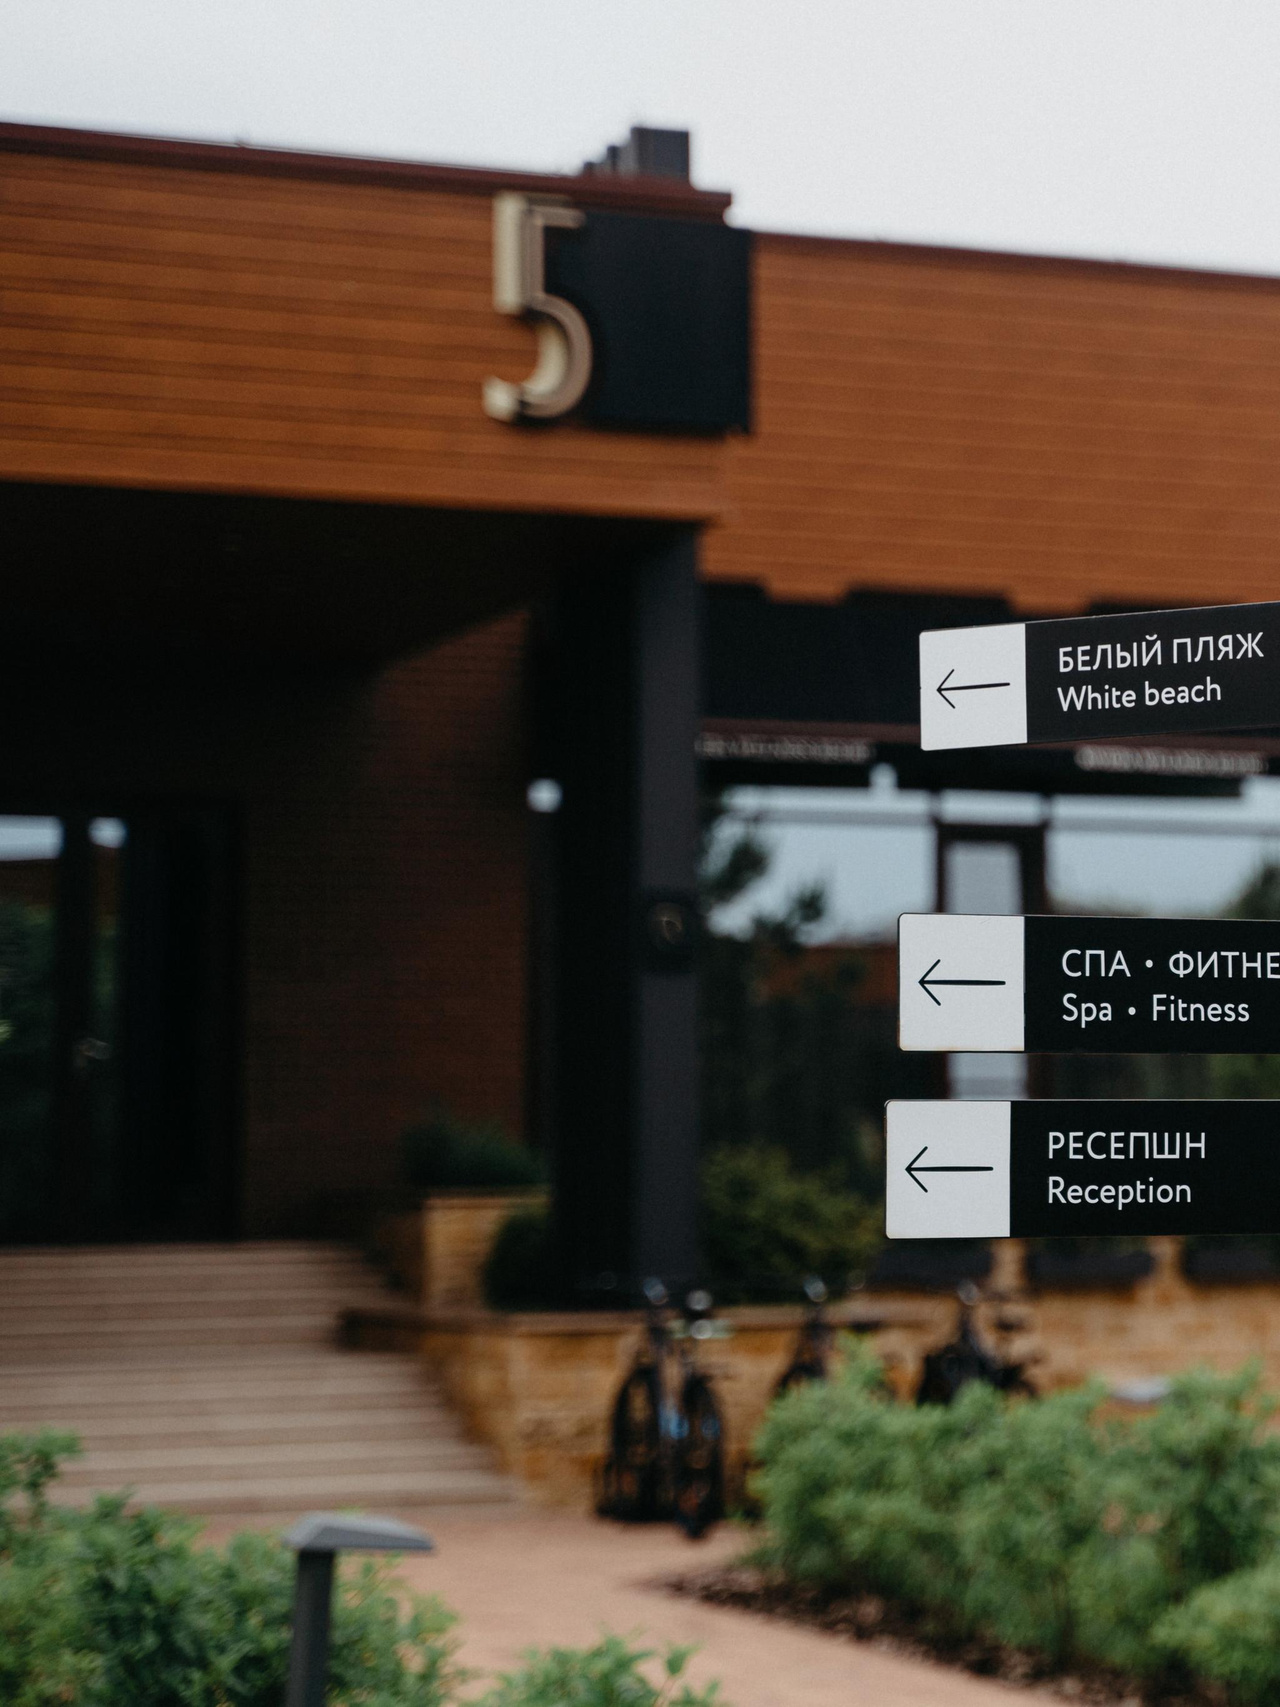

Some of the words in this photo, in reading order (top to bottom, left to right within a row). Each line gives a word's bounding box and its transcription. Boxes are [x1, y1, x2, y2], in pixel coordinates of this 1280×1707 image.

[483, 192, 592, 421] 5
[1058, 633, 1162, 673] БЕЛЫЙ
[1172, 631, 1265, 664] ПЛЯЖ
[1056, 684, 1137, 712] White
[1144, 676, 1222, 706] beach
[1061, 948, 1132, 978] СПА
[1062, 992, 1113, 1029] Spa
[1152, 993, 1250, 1022] Fitness
[1048, 1131, 1206, 1160] РЕСЕПШН
[1048, 1175, 1192, 1211] Reception
